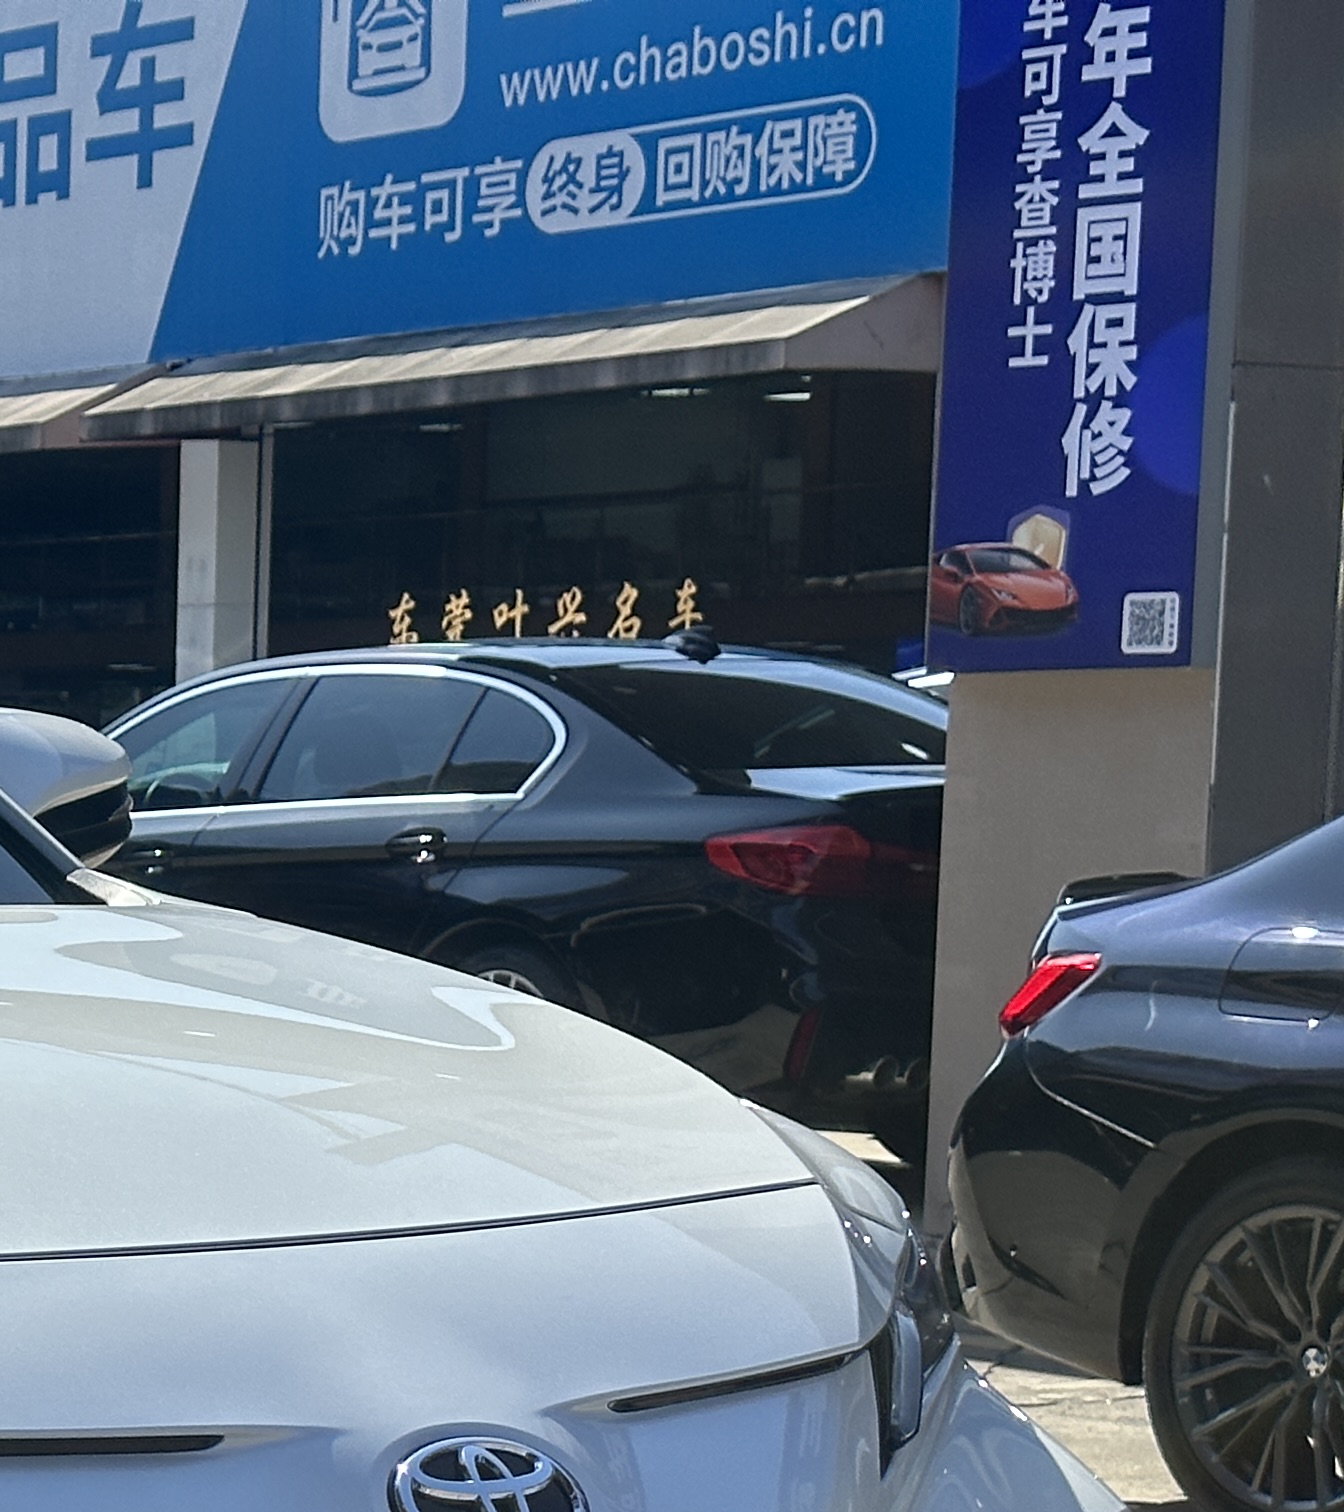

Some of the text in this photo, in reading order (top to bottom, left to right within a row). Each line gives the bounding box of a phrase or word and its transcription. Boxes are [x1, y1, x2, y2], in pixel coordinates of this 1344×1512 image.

[499, 7, 885, 107] www.chaboshi.cn
[317, 107, 859, 260] 购车可享 终身 回购保障
[1061, 2, 1153, 498] 年全国保修
